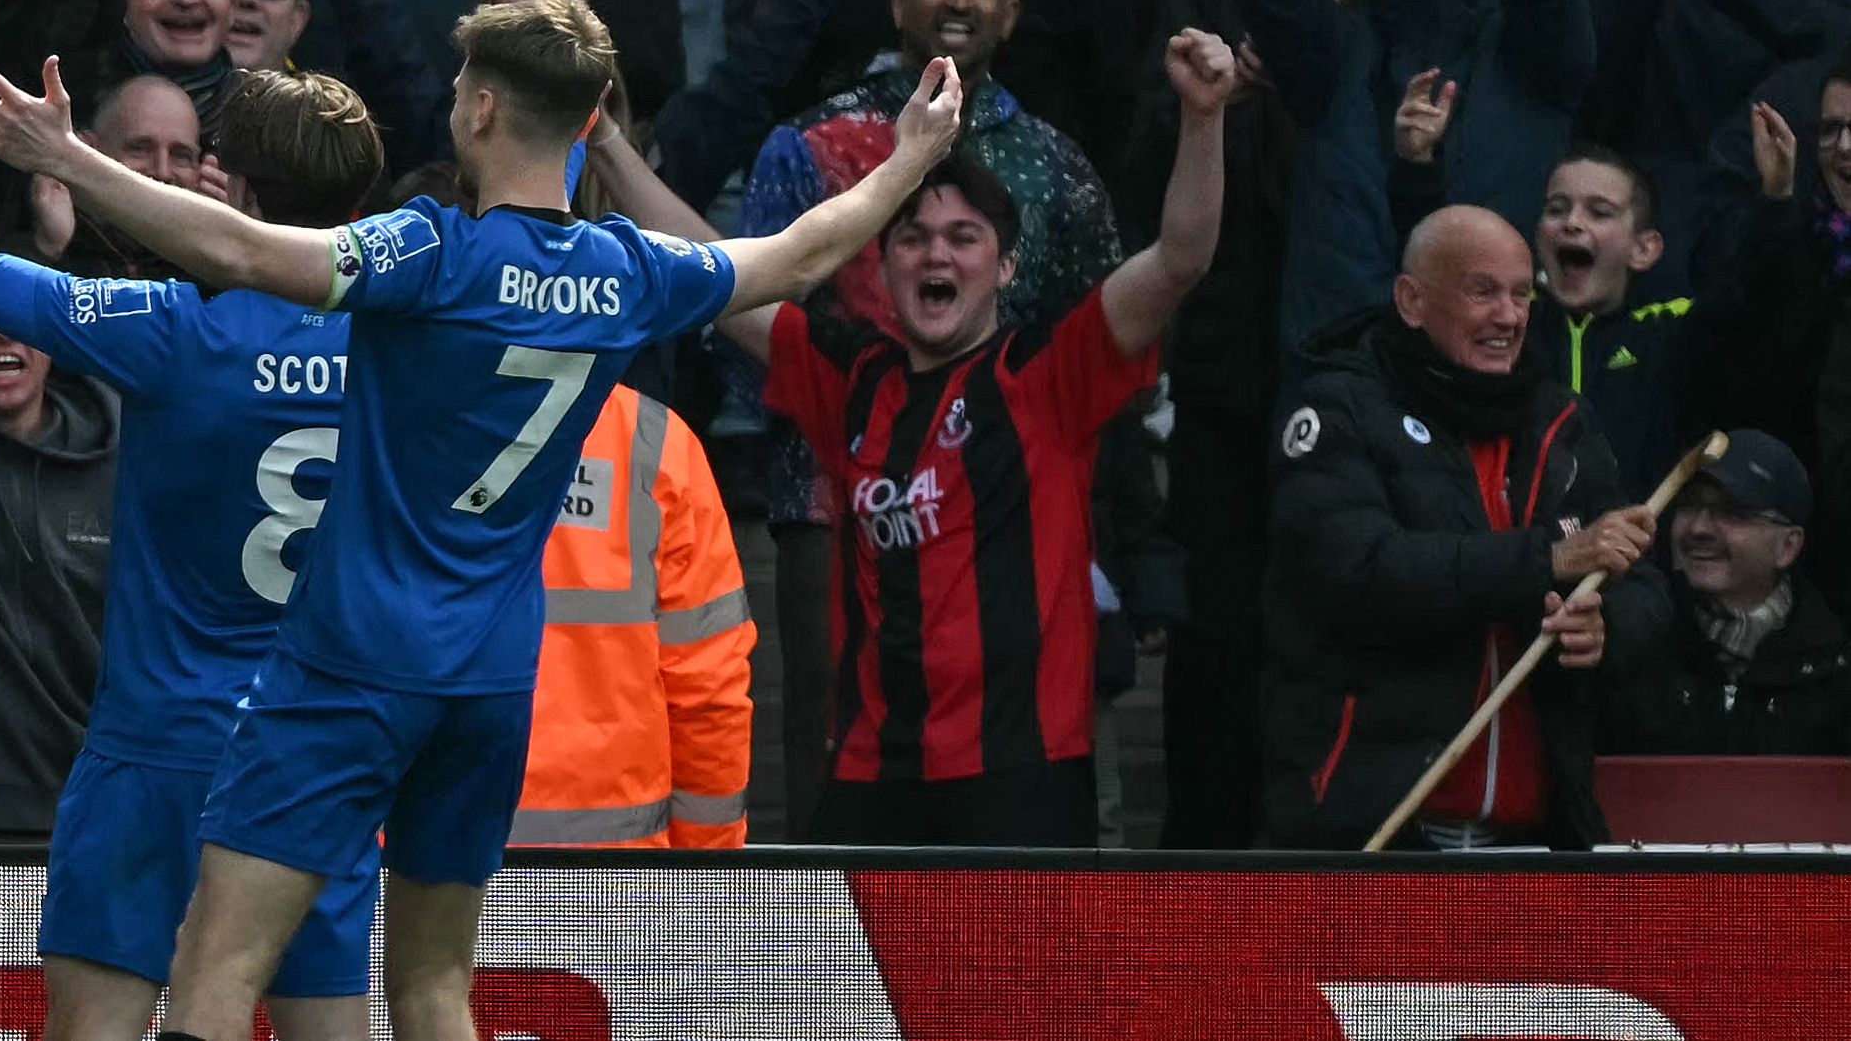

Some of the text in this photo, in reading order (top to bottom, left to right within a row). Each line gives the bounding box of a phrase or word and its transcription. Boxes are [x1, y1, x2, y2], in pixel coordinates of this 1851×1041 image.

[500, 264, 621, 317] BROOKS
[451, 346, 597, 514] 7
[241, 427, 340, 605] 8
